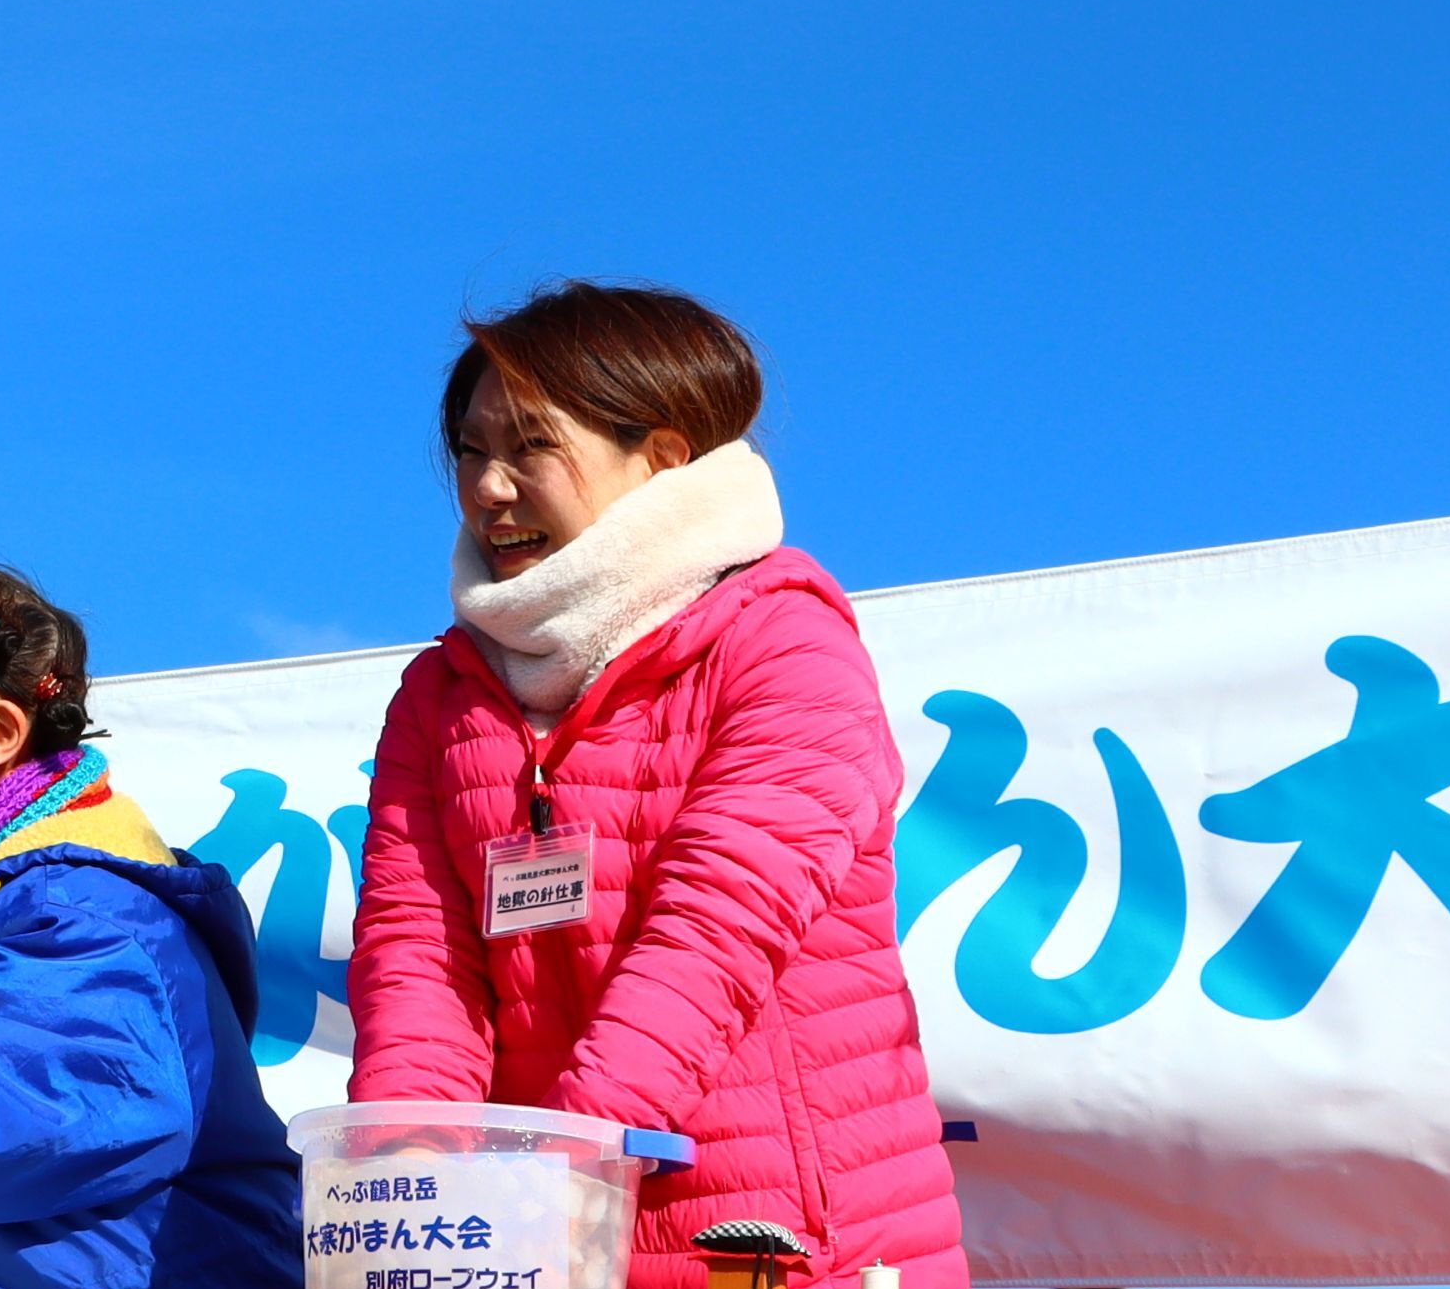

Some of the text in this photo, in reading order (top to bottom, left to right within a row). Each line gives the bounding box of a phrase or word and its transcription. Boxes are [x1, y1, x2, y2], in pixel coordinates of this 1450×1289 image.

[496, 880, 584, 909] 地獄の針仕事
[326, 1175, 438, 1203] べっぷ鶴見岳
[307, 1214, 492, 1259] 大寒がまん大会
